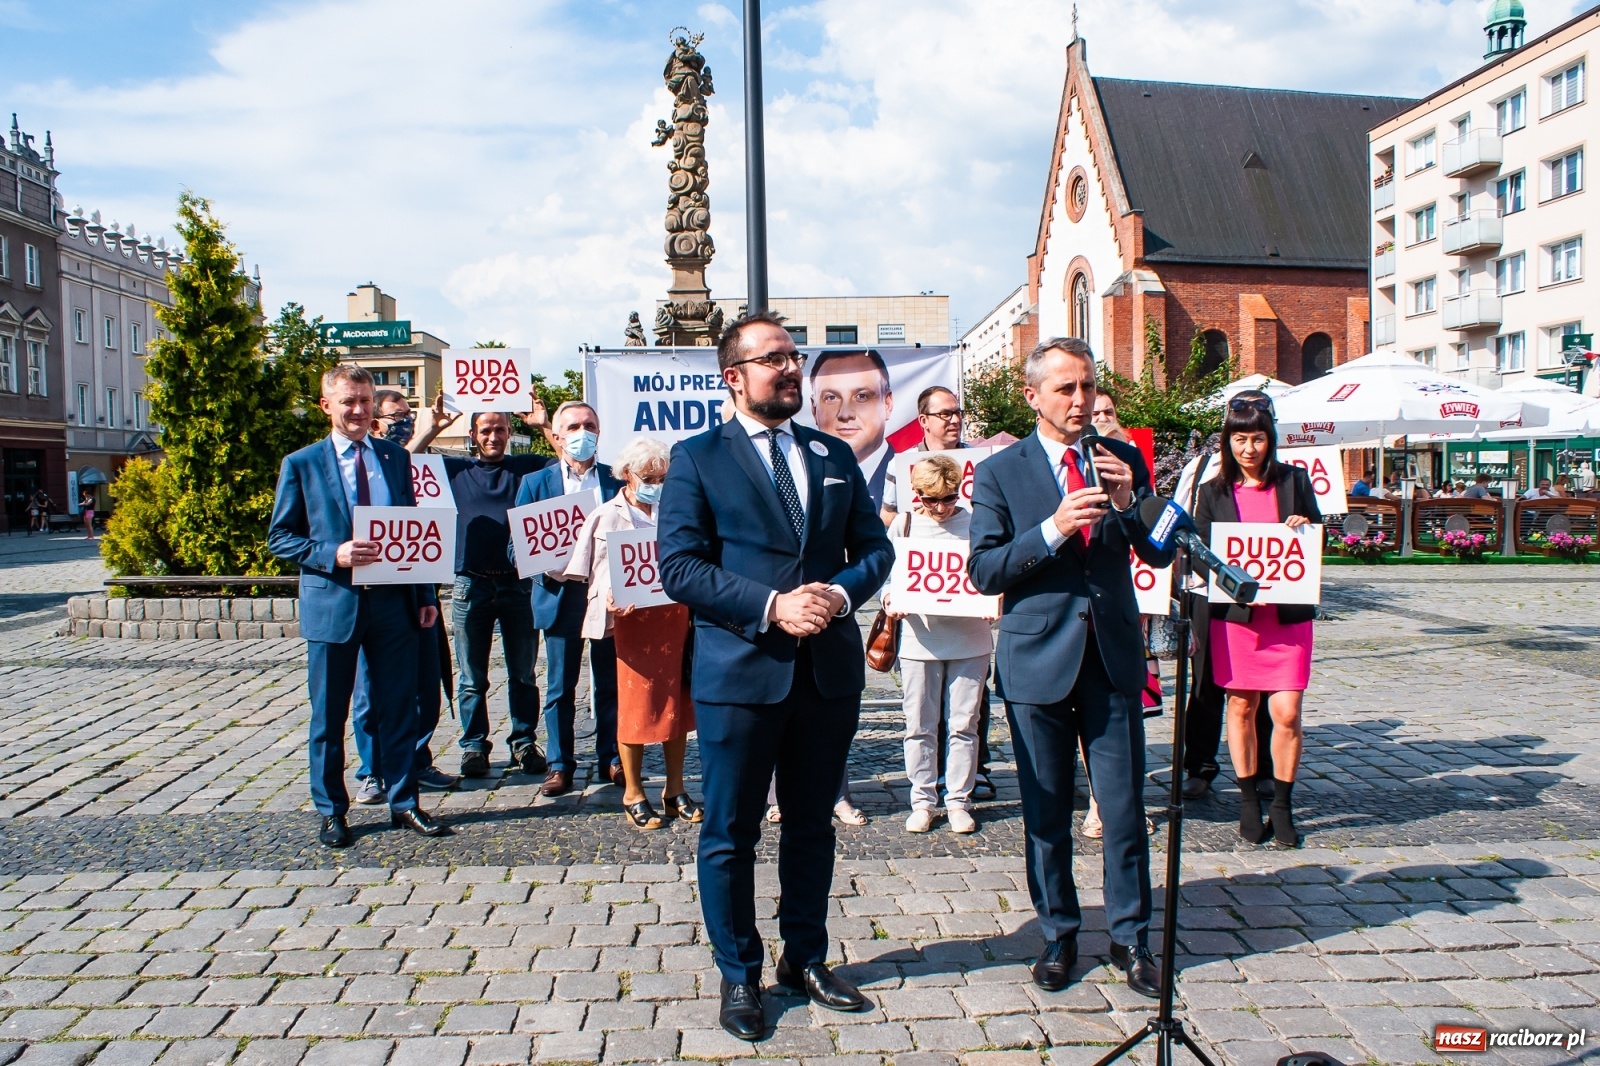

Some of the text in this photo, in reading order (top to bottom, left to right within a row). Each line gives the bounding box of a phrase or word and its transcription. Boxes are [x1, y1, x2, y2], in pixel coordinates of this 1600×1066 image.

[343, 330, 389, 338] McDonald's
[456, 359, 519, 377] DUDA
[456, 377, 520, 395] 2020
[633, 372, 728, 392] MÓJ PREZ
[633, 399, 724, 431] ANDR
[1445, 402, 1477, 414] ŻYWIEC
[412, 464, 437, 481] DA
[369, 520, 441, 541] DUDA
[522, 504, 587, 538] DUDA
[621, 540, 659, 566] DU
[1226, 536, 1305, 559] DUDA
[908, 550, 968, 574] DUD
[1227, 559, 1306, 581] 020
[623, 564, 662, 587] 20
